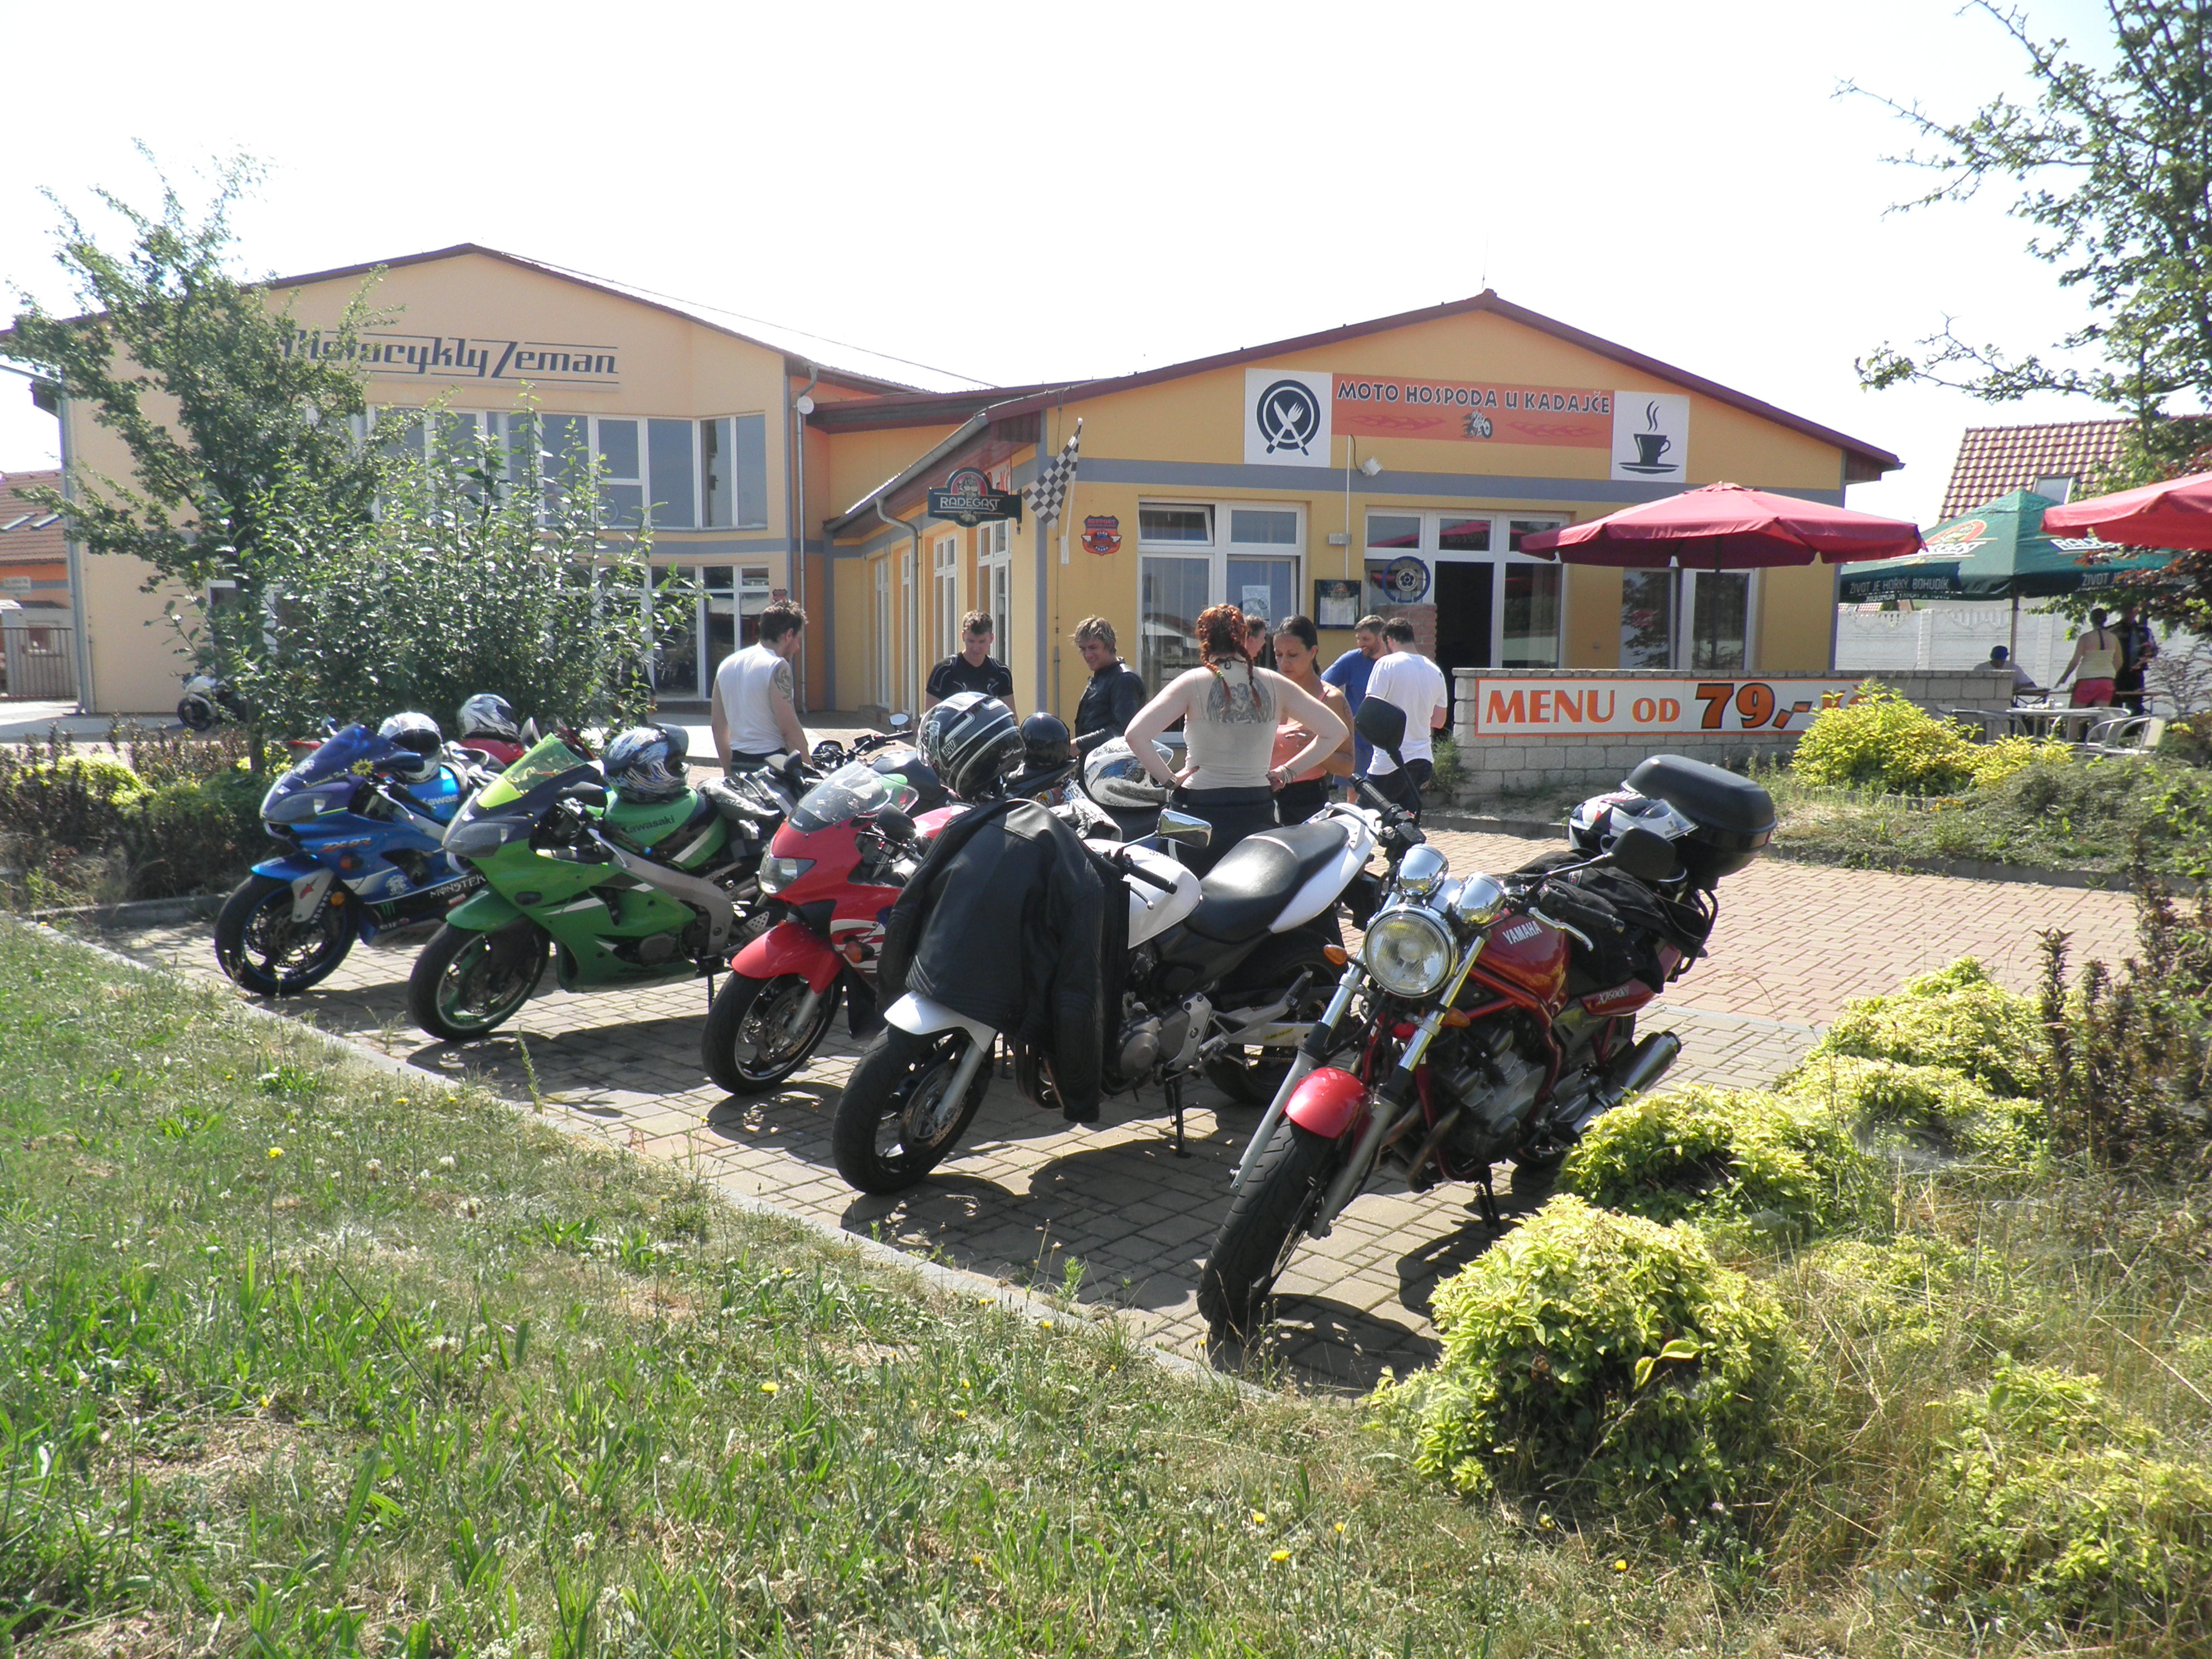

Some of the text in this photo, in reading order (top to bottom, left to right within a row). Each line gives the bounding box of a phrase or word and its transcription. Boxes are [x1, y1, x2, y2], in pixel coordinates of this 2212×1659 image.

[1337, 381, 1399, 402] MOTO
[1405, 385, 1498, 408] HOSPODA
[1524, 391, 1611, 415] KADAJČE
[940, 497, 1000, 512] RADEGAST
[1850, 581, 1871, 594] ŽIVOT
[1873, 580, 1881, 591] JE
[2082, 572, 2109, 585] ŽIVOT
[1486, 690, 1615, 724] MENU
[1632, 697, 1680, 723] OD
[1502, 920, 1542, 944] YAMAHA
